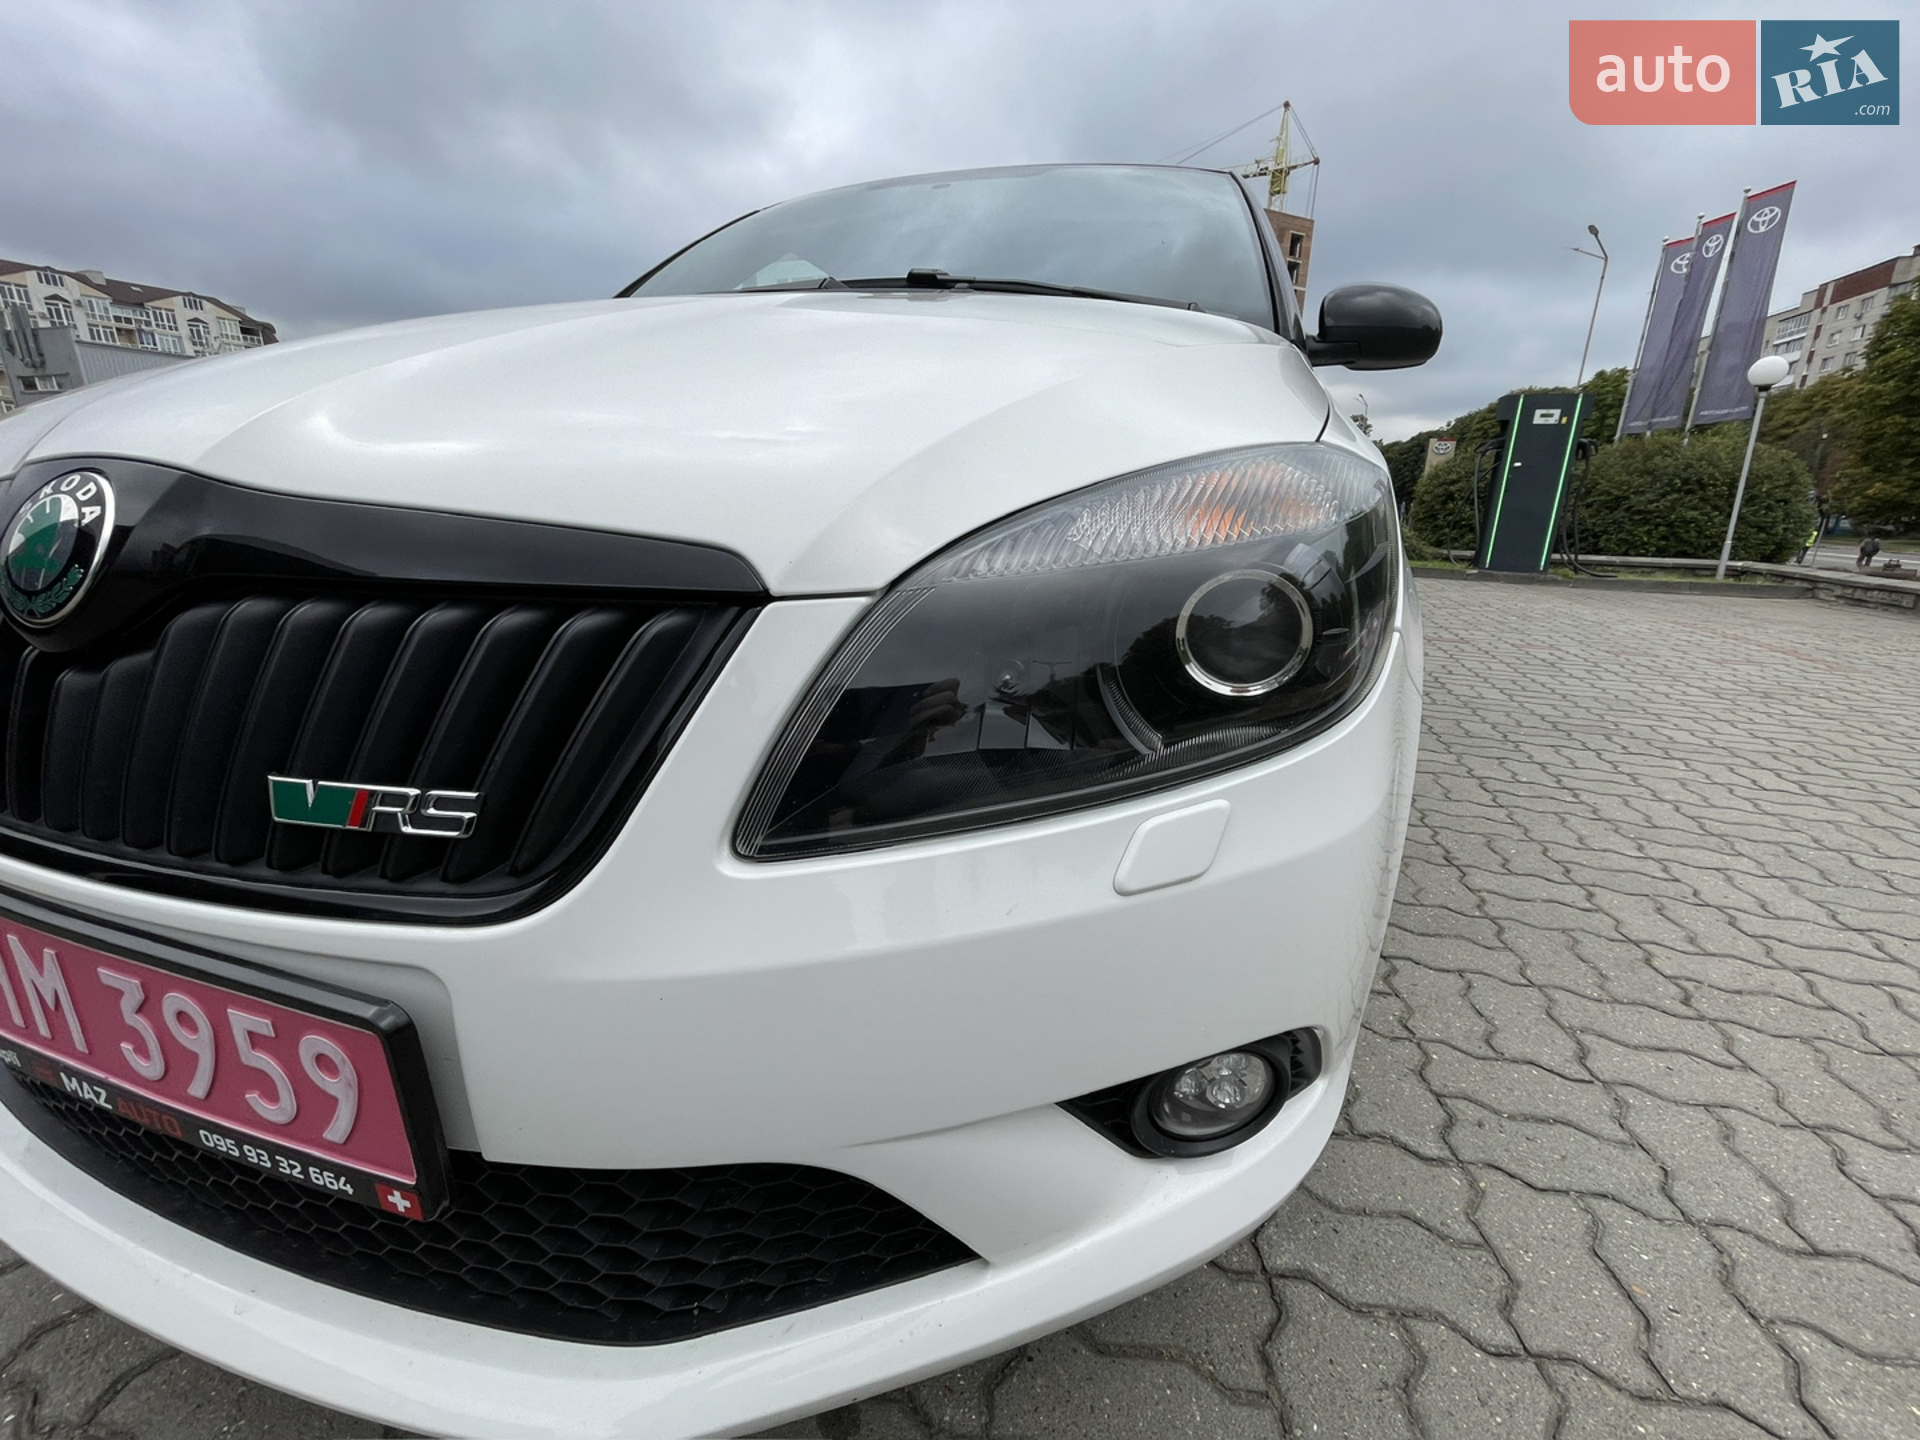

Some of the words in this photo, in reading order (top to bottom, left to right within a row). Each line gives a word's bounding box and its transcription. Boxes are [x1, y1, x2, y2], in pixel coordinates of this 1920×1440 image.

[97, 967, 359, 1145] 3959
[59, 1071, 113, 1110] MAZ
[117, 1097, 183, 1138] AUTO
[199, 1129, 240, 1157] 095
[243, 1144, 272, 1168] 93
[275, 1155, 305, 1179] 32
[308, 1166, 354, 1195] 664
